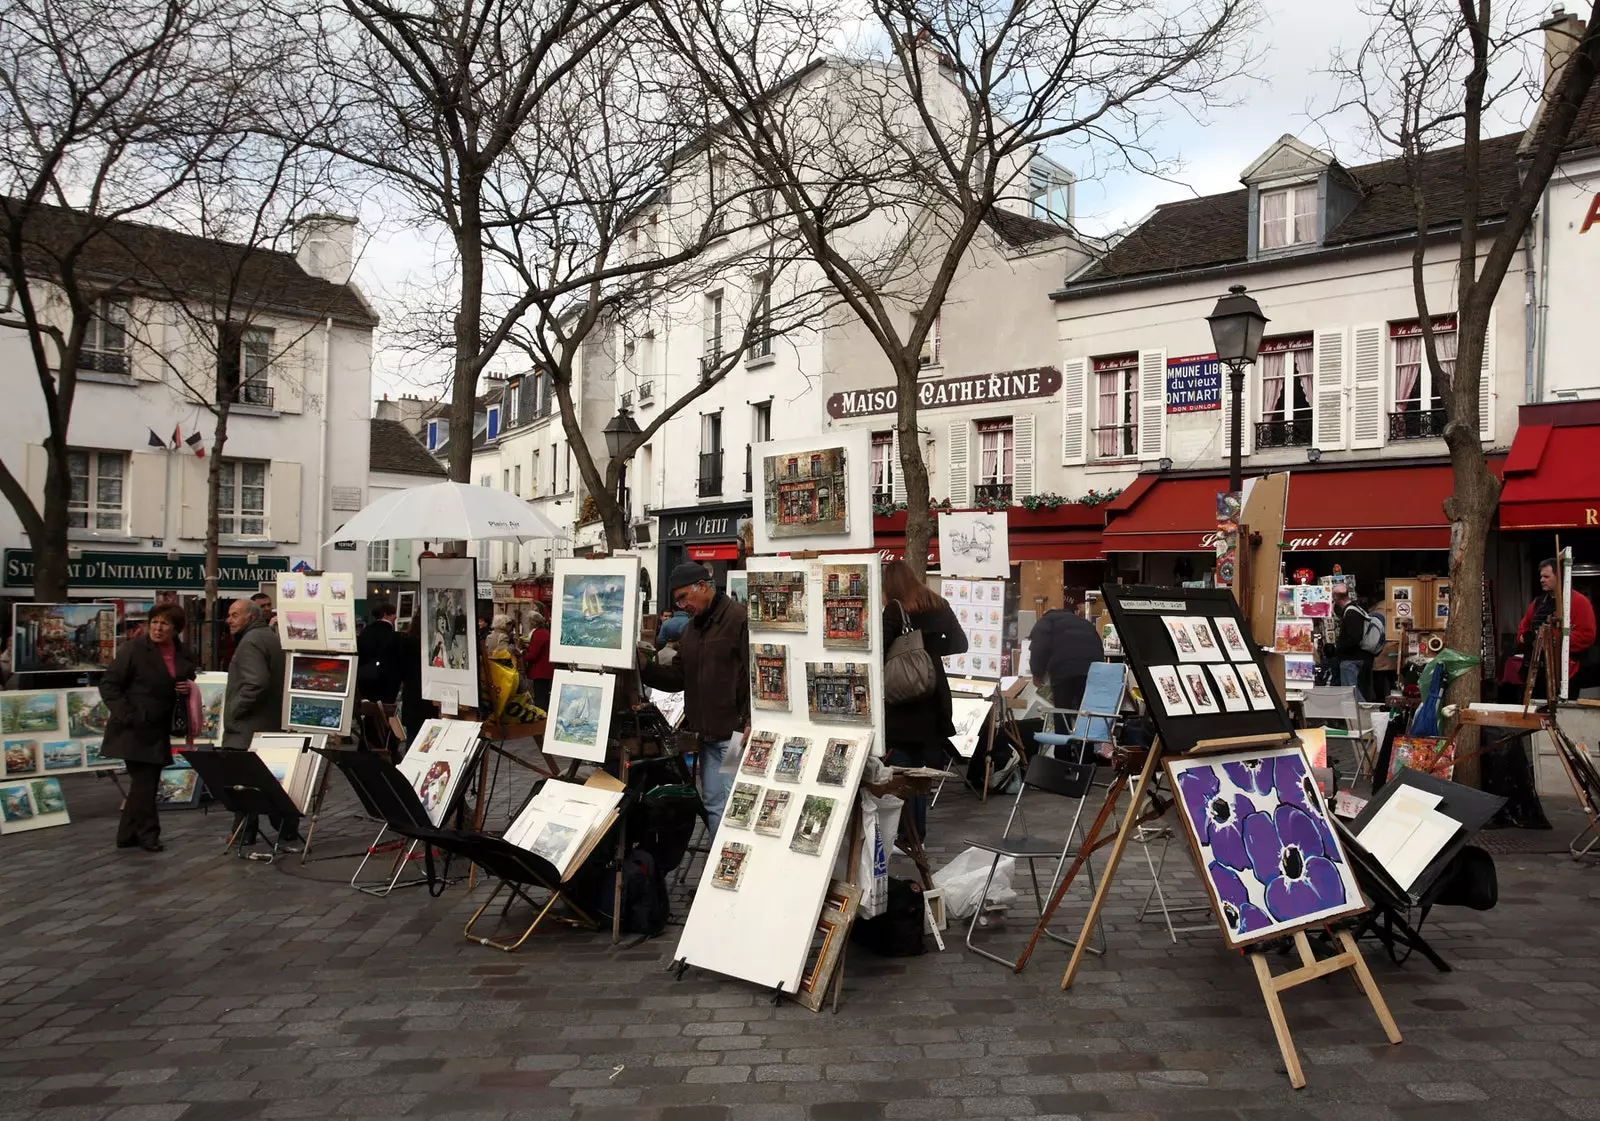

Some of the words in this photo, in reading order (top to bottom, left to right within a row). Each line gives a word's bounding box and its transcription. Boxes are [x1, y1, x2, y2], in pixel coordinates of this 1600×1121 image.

[1167, 365, 1200, 380] MMUNE
[1204, 363, 1222, 376] LIB
[1171, 379, 1184, 389] du
[1187, 377, 1217, 388] vieux
[842, 390, 897, 414] MAISO
[1167, 388, 1222, 404] ONTMART
[1189, 403, 1216, 411] DUNLOP
[1289, 533, 1322, 551] qui
[1327, 531, 1354, 546] lit
